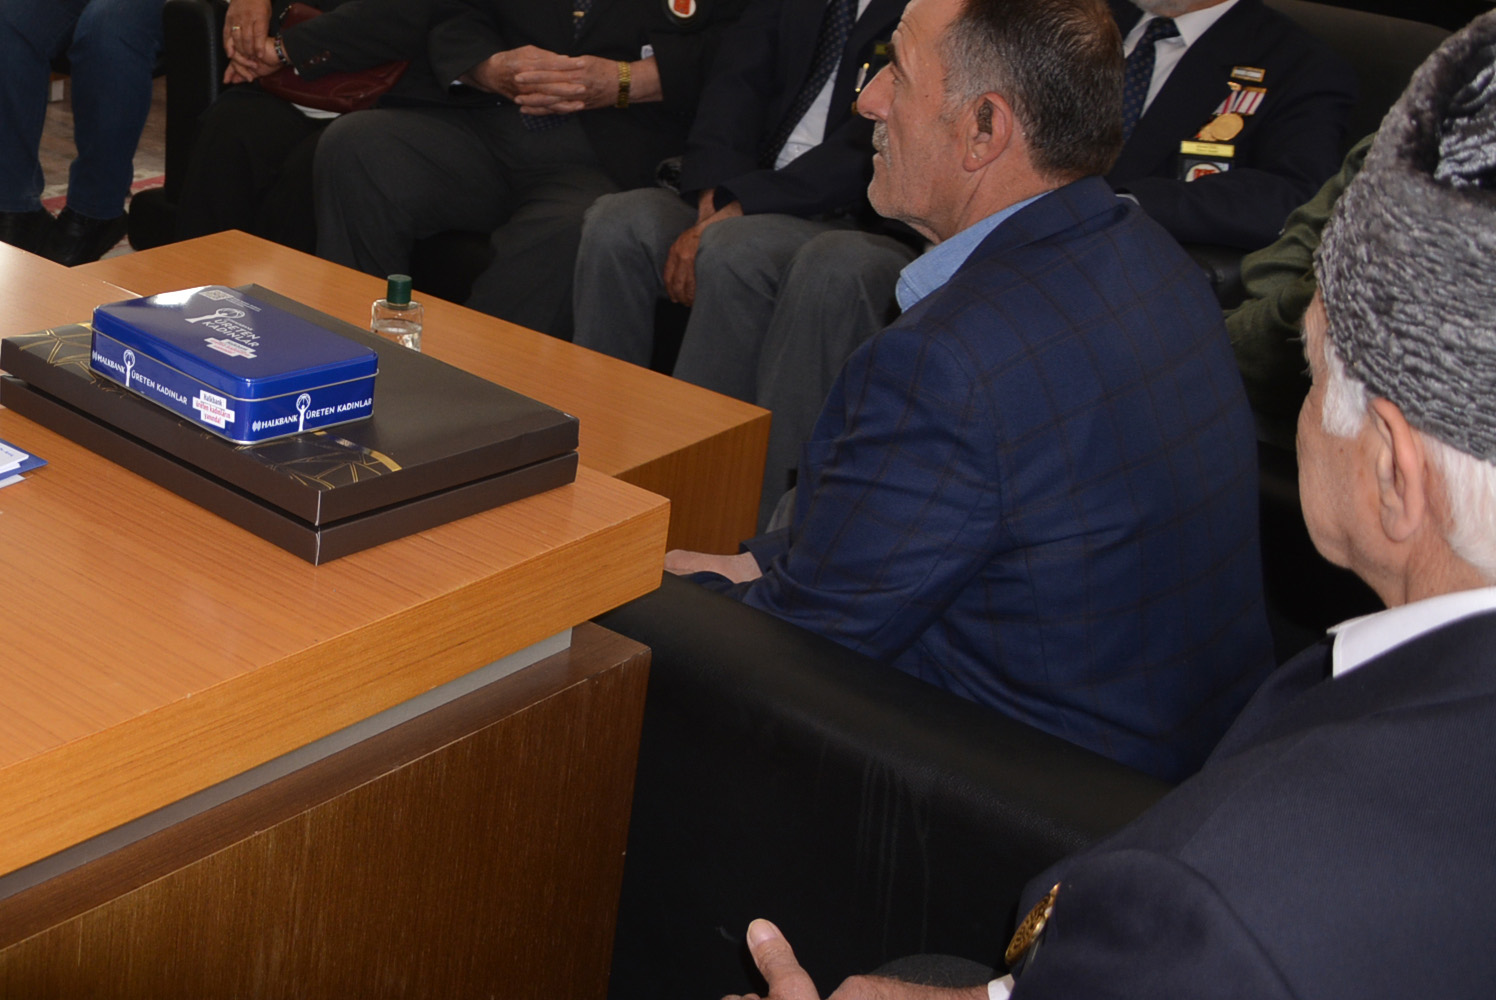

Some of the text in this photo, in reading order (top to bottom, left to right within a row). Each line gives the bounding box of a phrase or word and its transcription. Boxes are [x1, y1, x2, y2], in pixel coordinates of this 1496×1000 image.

[203, 321, 260, 347] KADINLAR
[215, 318, 261, 340] ÜRETEN
[97, 354, 188, 405] HALKBANK ÜRETEN KADINLAR
[262, 398, 372, 429] HALKBANK ÜRETEN KADINLAR
